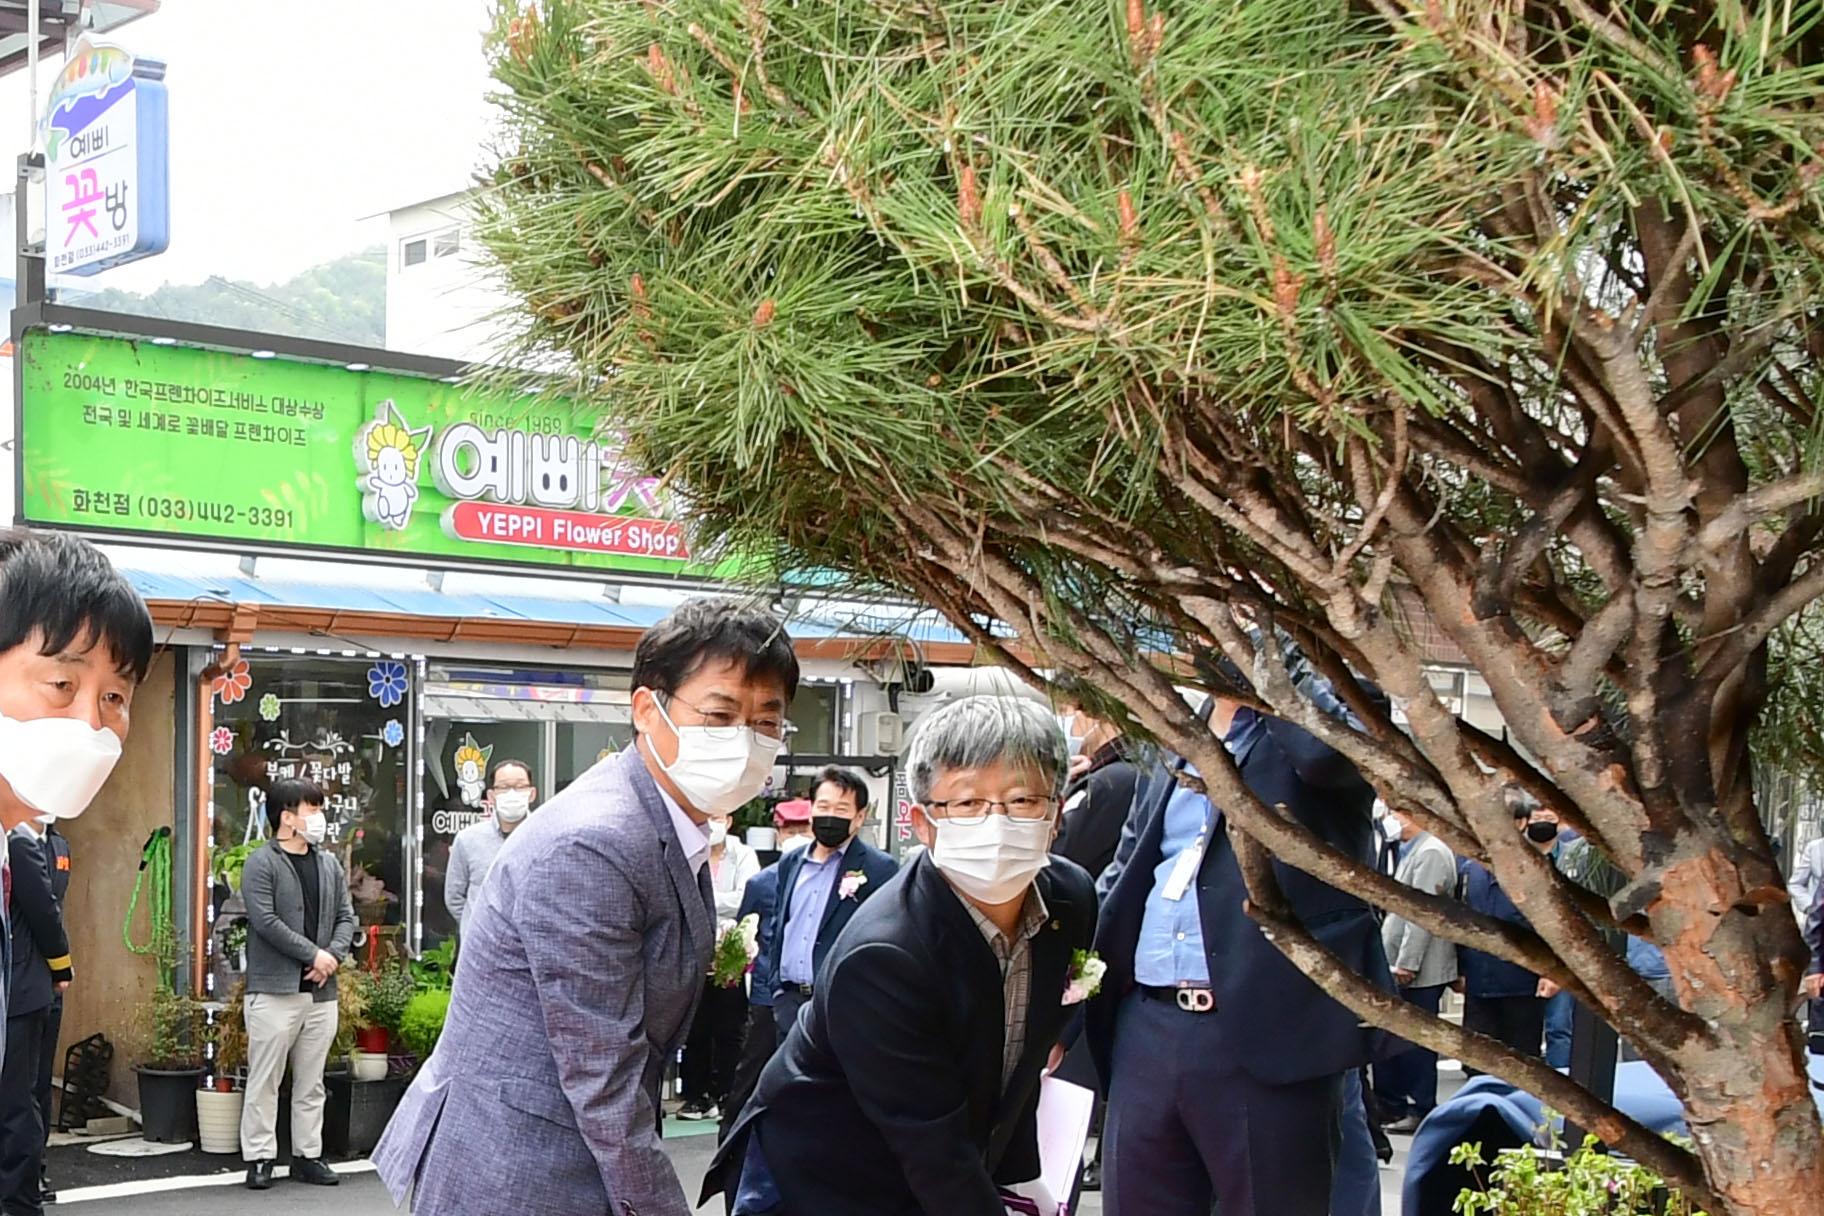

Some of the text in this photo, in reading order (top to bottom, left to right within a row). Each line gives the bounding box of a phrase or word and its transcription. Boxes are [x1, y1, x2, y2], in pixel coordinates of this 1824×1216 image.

[70, 124, 109, 158] 예삐
[63, 372, 116, 396] 2004년
[83, 404, 307, 447] 전국 및 세계로 꽃배달 프렌차이즈
[73, 488, 294, 529] 화천점 (033)442-3391
[477, 510, 679, 555] YEPPI Flower Shop
[310, 760, 352, 785] 꽃다발
